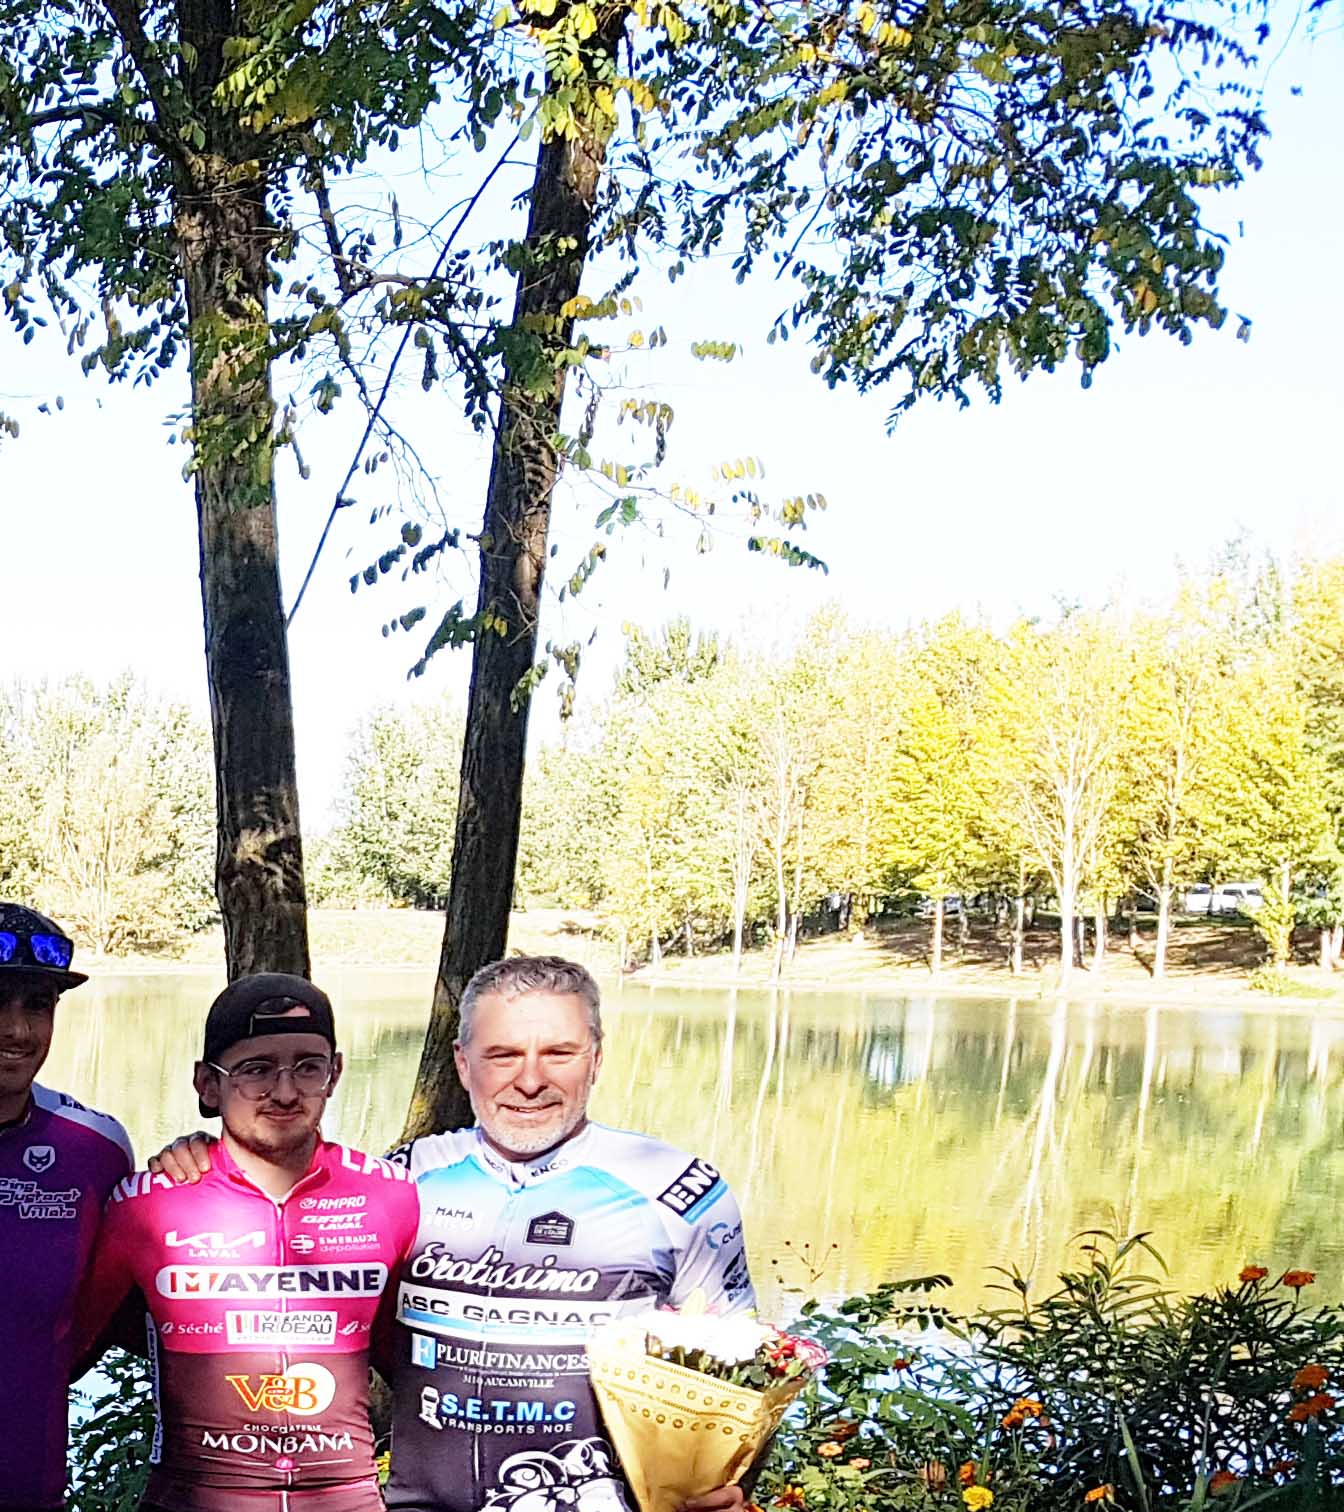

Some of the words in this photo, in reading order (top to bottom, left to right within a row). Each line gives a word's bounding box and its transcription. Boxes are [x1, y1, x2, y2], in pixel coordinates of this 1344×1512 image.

[317, 1195, 367, 1210] RMPRO
[188, 1248, 241, 1259] LAVAL
[169, 1269, 381, 1293] MAYENNE
[401, 1292, 450, 1316] ASC
[462, 1304, 612, 1327] GAGNAC
[177, 1319, 224, 1334] Séché
[436, 1342, 591, 1371] PLURIFINANCES
[442, 1416, 536, 1434] TRANSPORTS
[543, 1423, 574, 1433] NOE
[201, 1431, 354, 1454] MONBANA
